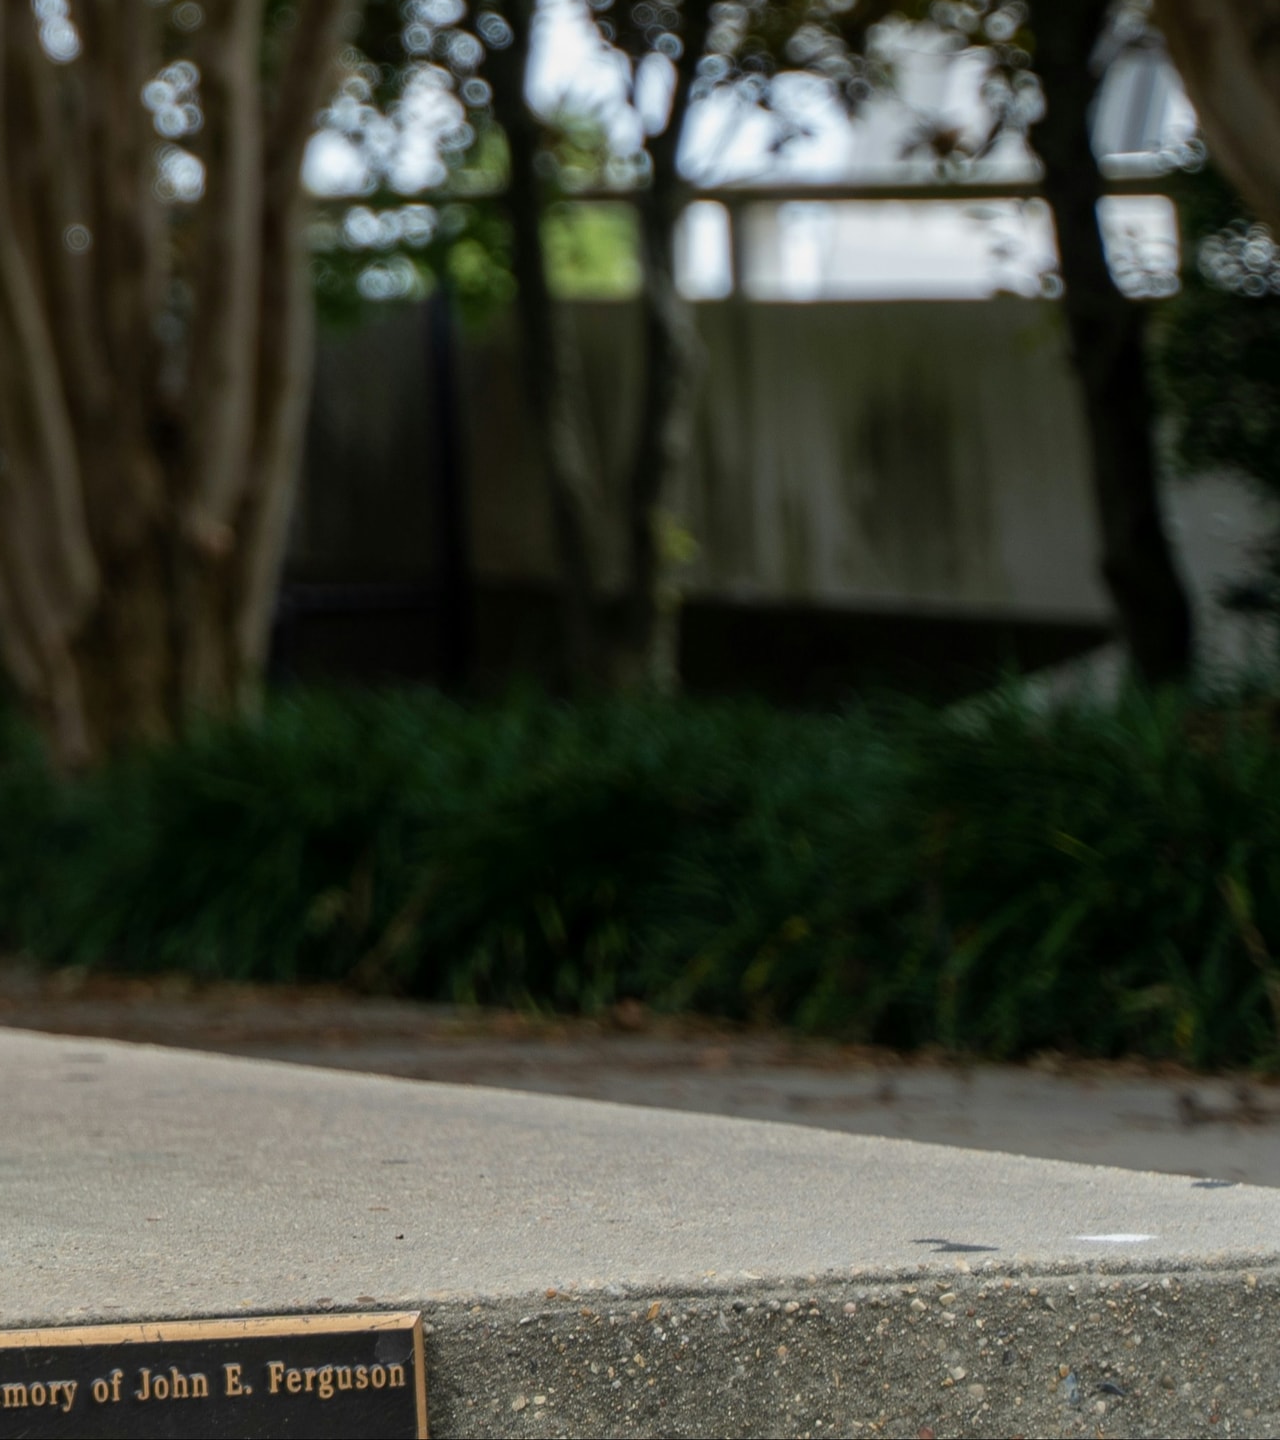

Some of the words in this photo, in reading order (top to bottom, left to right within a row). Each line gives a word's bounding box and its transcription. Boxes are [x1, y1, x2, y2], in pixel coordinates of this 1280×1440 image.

[92, 1369, 123, 1403] of
[136, 1367, 209, 1402] John
[224, 1363, 253, 1396] E.
[268, 1361, 407, 1399] Ferguson
